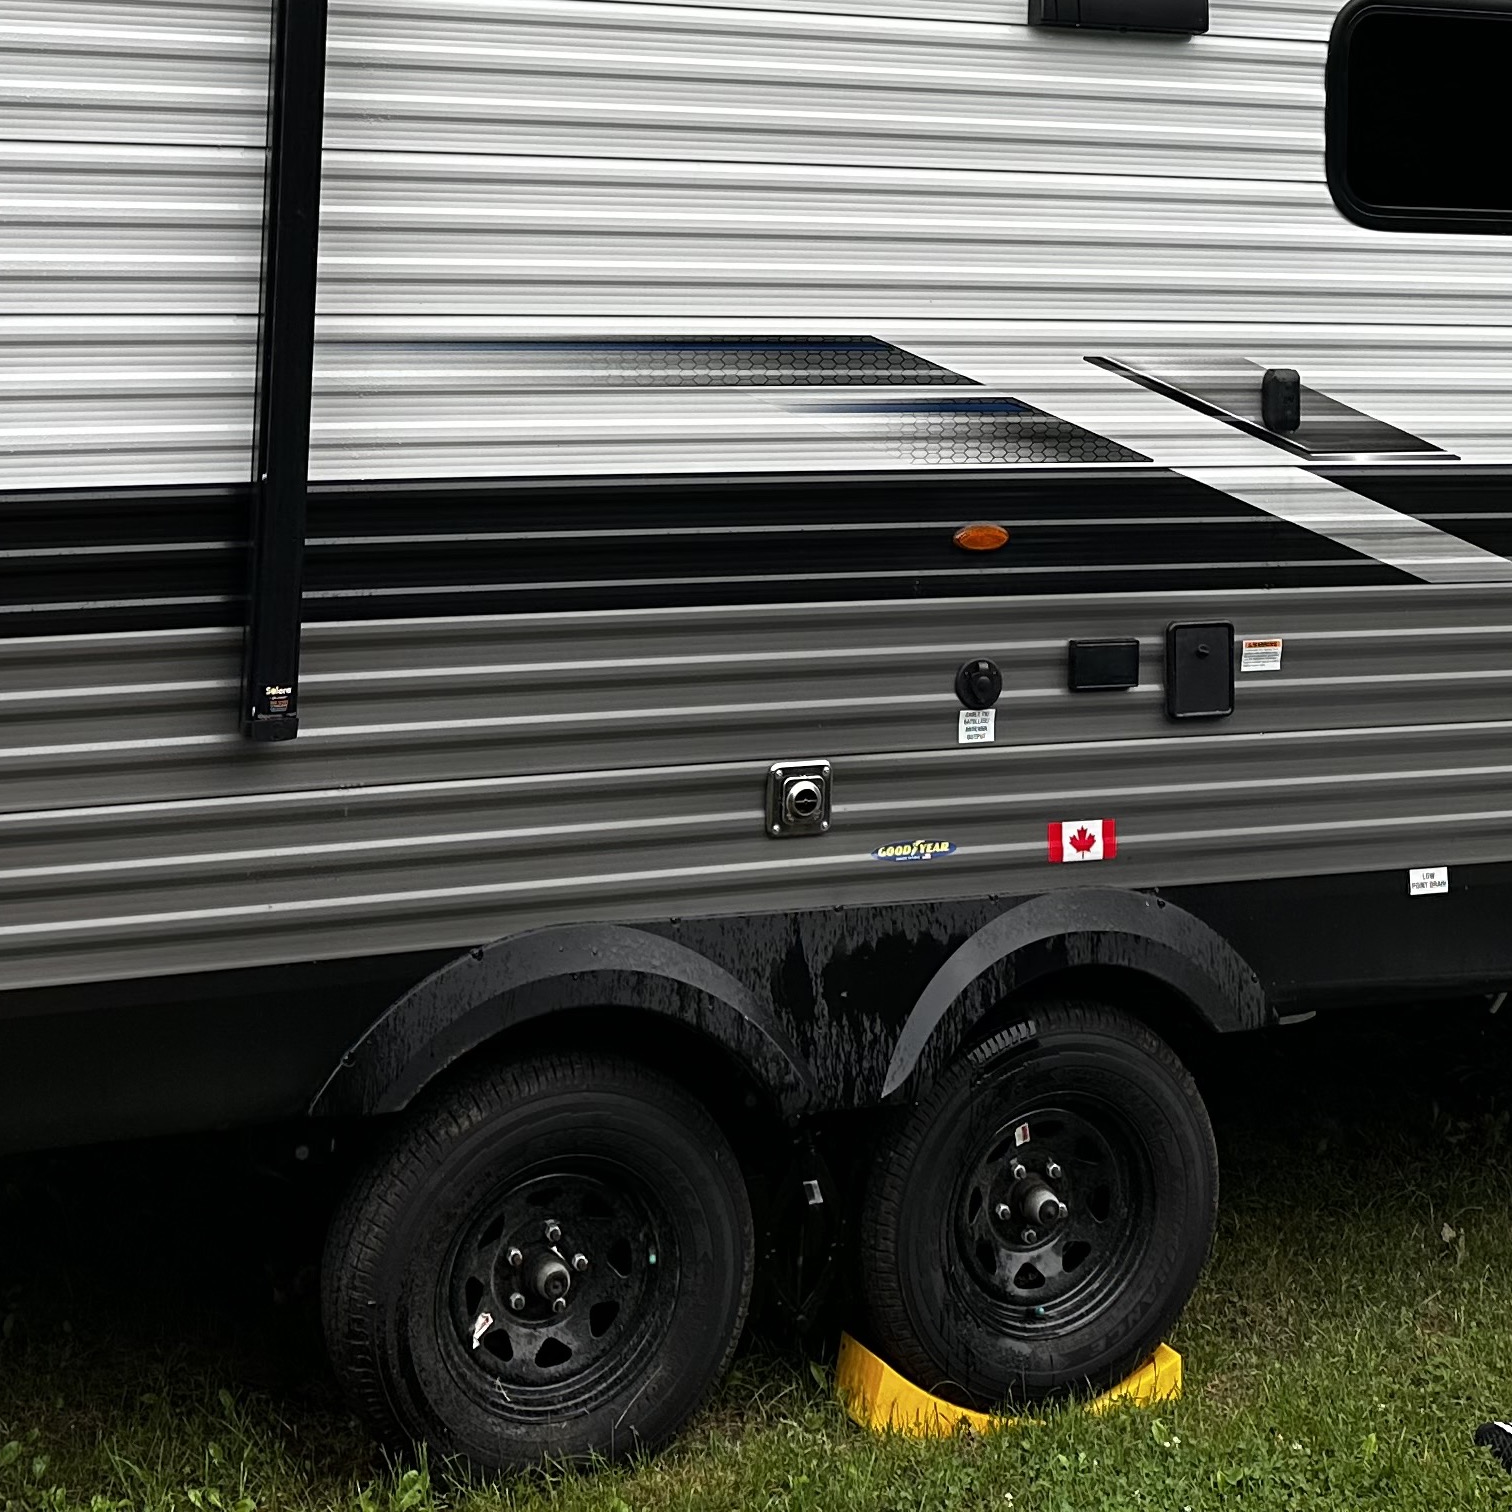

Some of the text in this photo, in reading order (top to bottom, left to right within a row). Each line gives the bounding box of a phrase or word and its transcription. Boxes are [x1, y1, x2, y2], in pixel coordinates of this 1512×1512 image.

[265, 685, 292, 695] Solera
[1422, 872, 1435, 880] LOW
[1411, 881, 1428, 889] POINT
